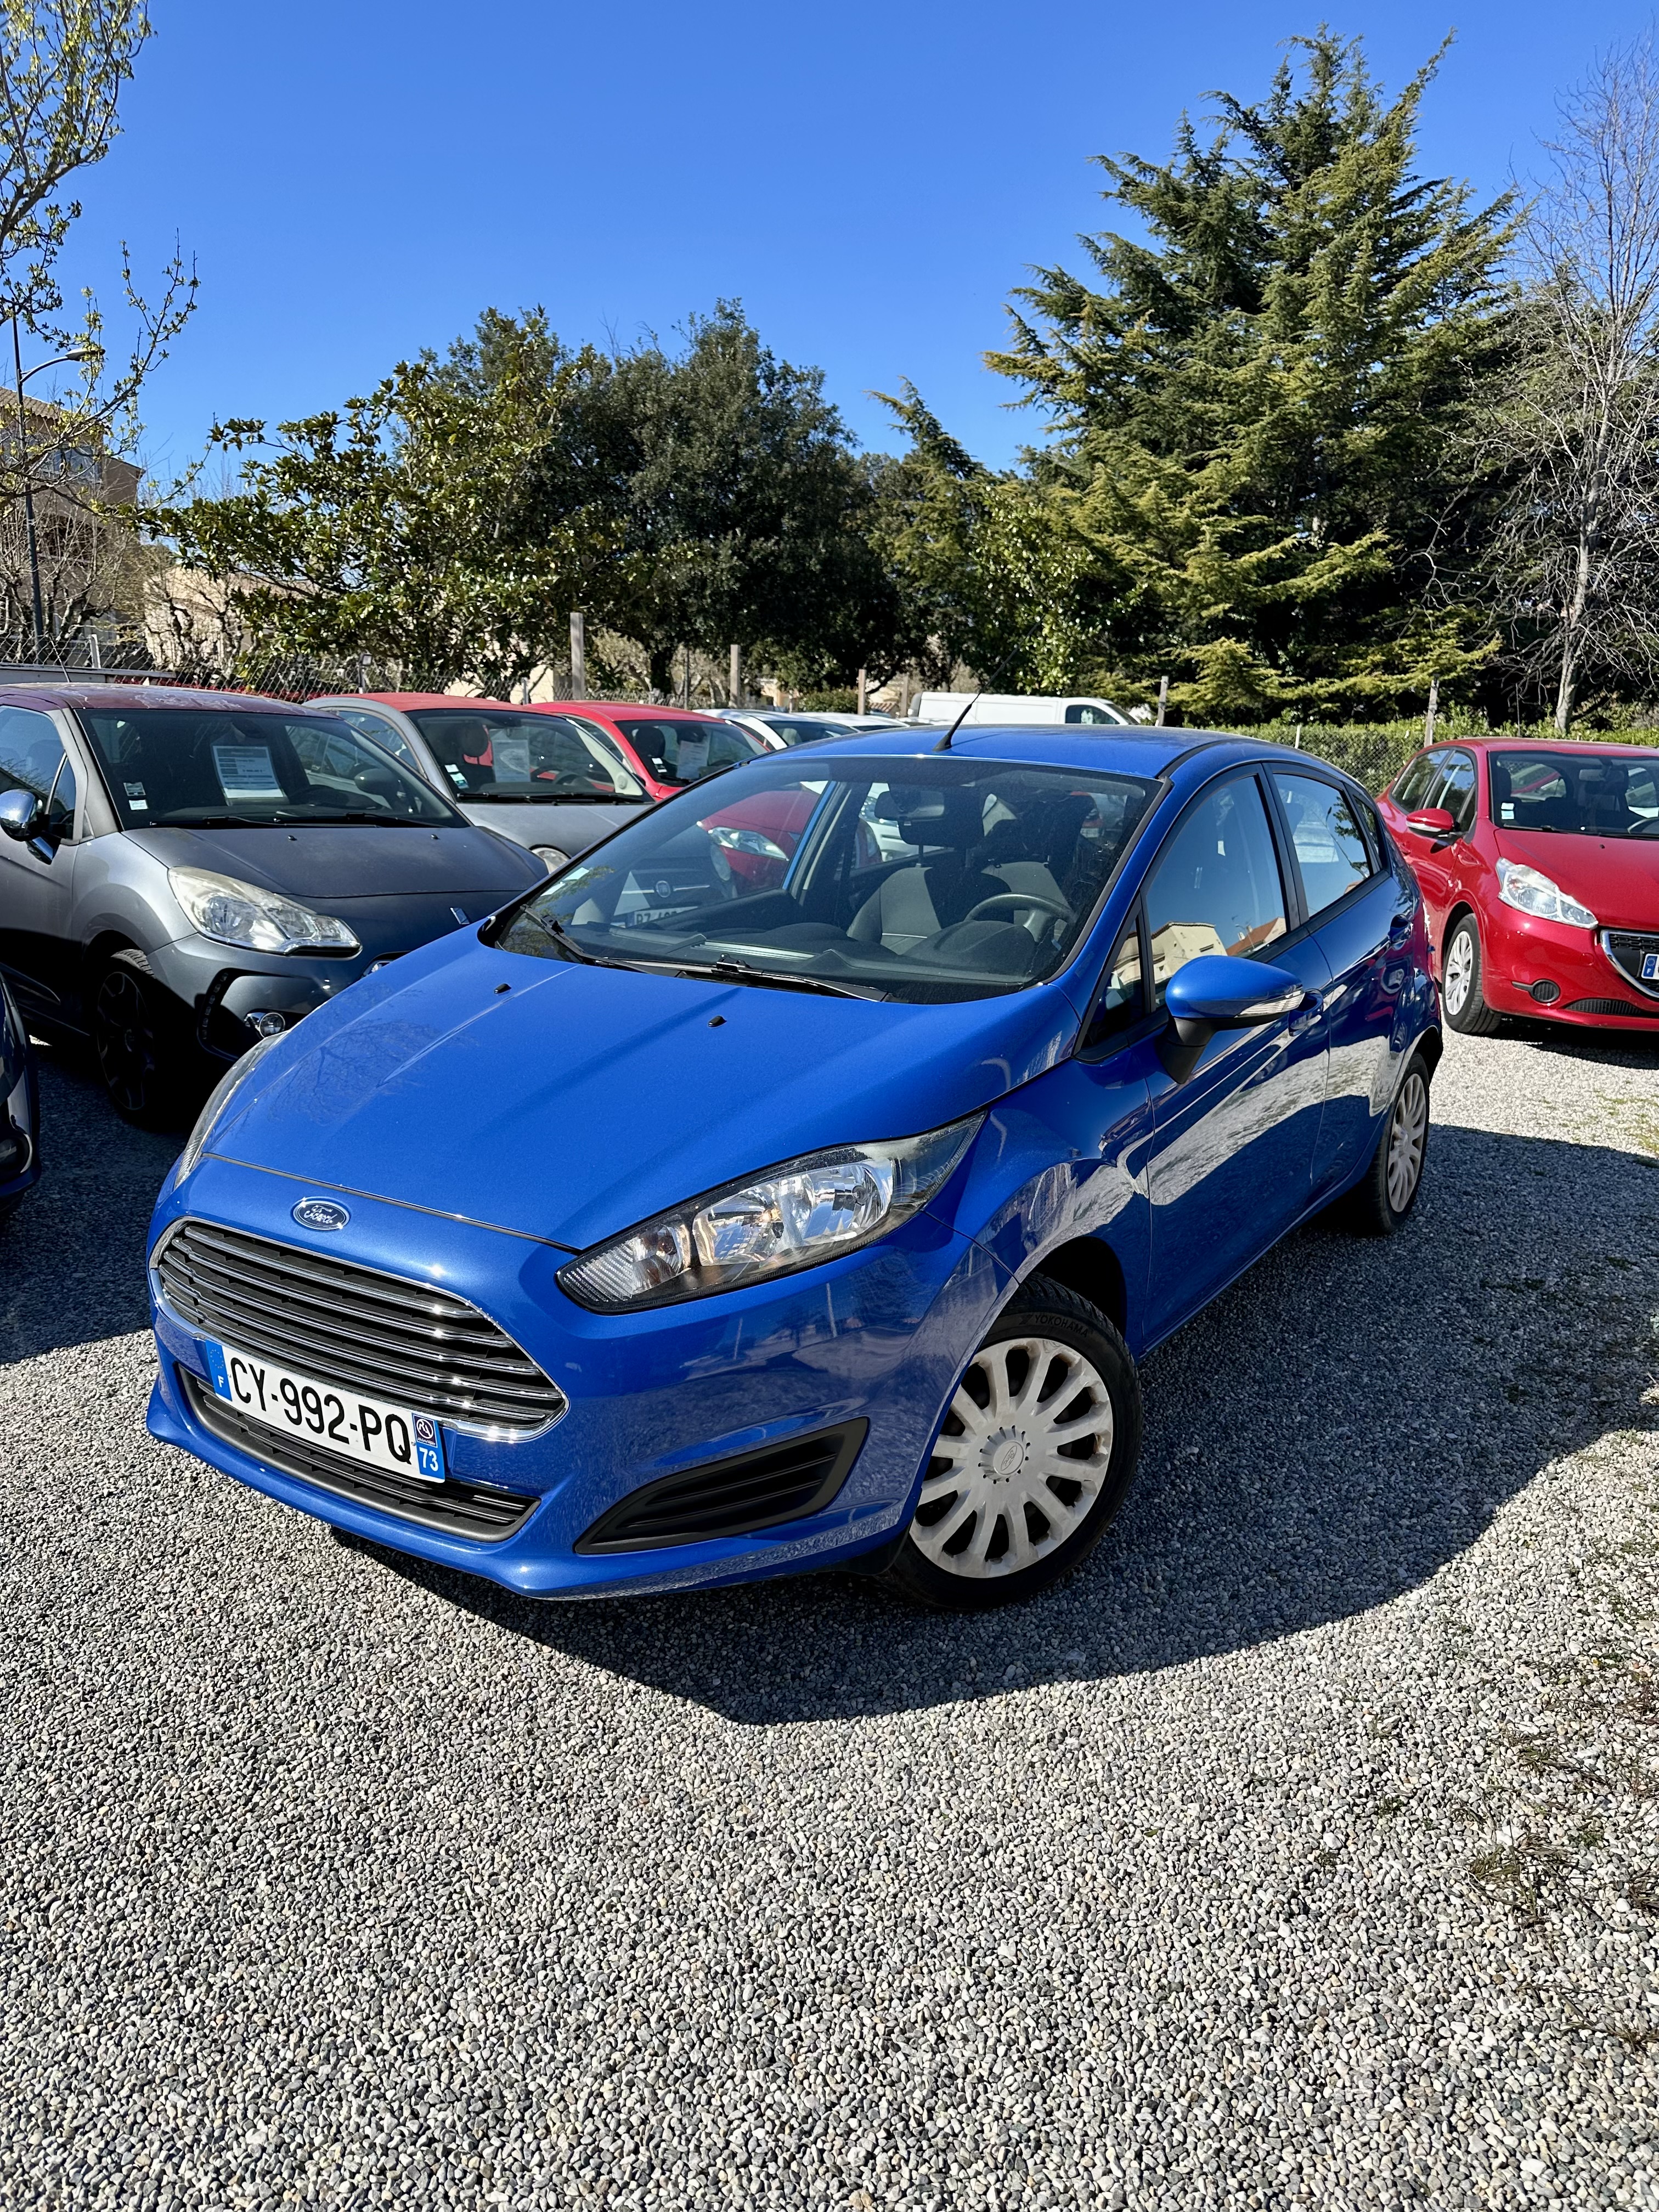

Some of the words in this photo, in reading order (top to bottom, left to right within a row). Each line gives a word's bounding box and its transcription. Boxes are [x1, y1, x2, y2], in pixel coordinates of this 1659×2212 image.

[303, 1205, 338, 1224] Ford
[1035, 1314, 1088, 1338] YOKOHAMA
[219, 1375, 224, 1388] F
[230, 1357, 411, 1465] CY-992-PQ
[419, 1447, 439, 1471] 73
